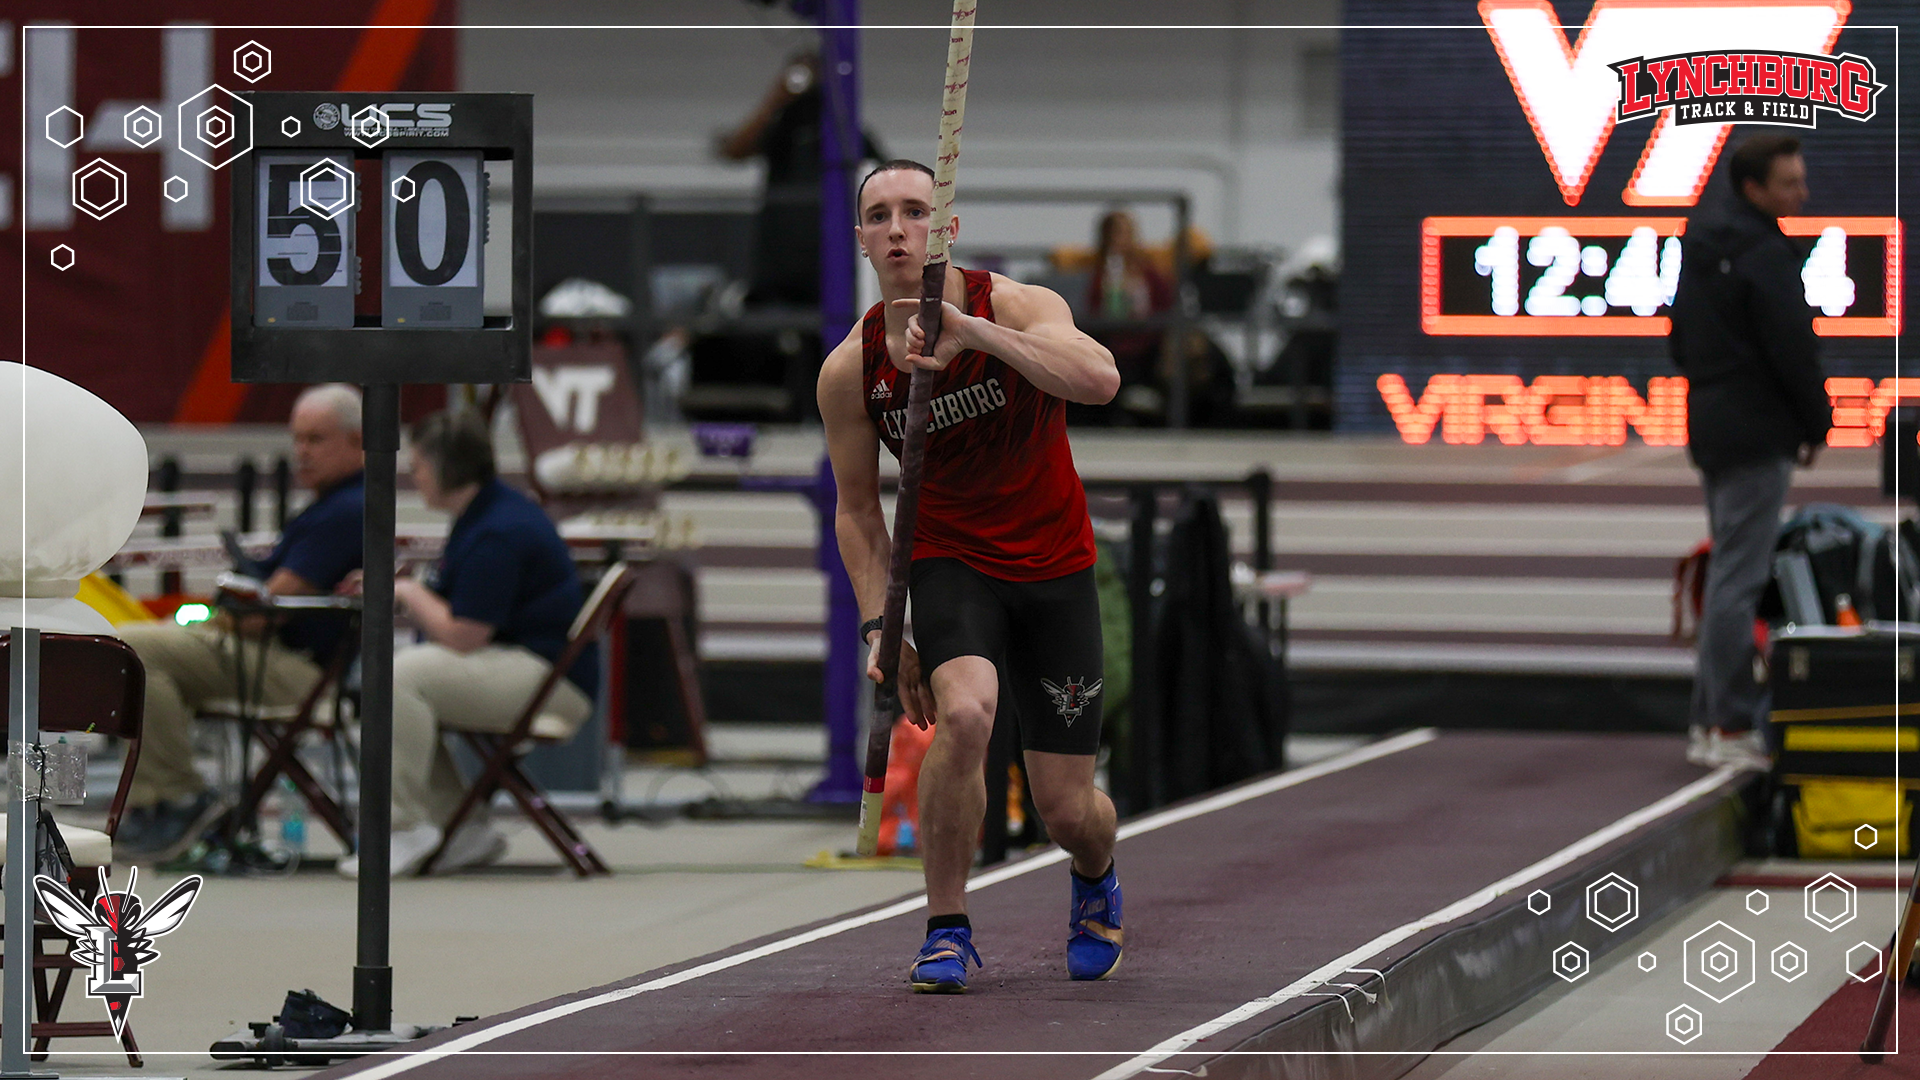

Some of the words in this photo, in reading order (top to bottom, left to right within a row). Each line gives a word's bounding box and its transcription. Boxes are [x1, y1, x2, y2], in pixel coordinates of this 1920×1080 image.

[0, 20, 213, 231] H
[341, 103, 453, 127] UCS
[531, 364, 617, 433] VT
[871, 391, 893, 400] adidas
[882, 377, 1007, 440] LYHBURG
[1377, 374, 1689, 446] VIRGINI
